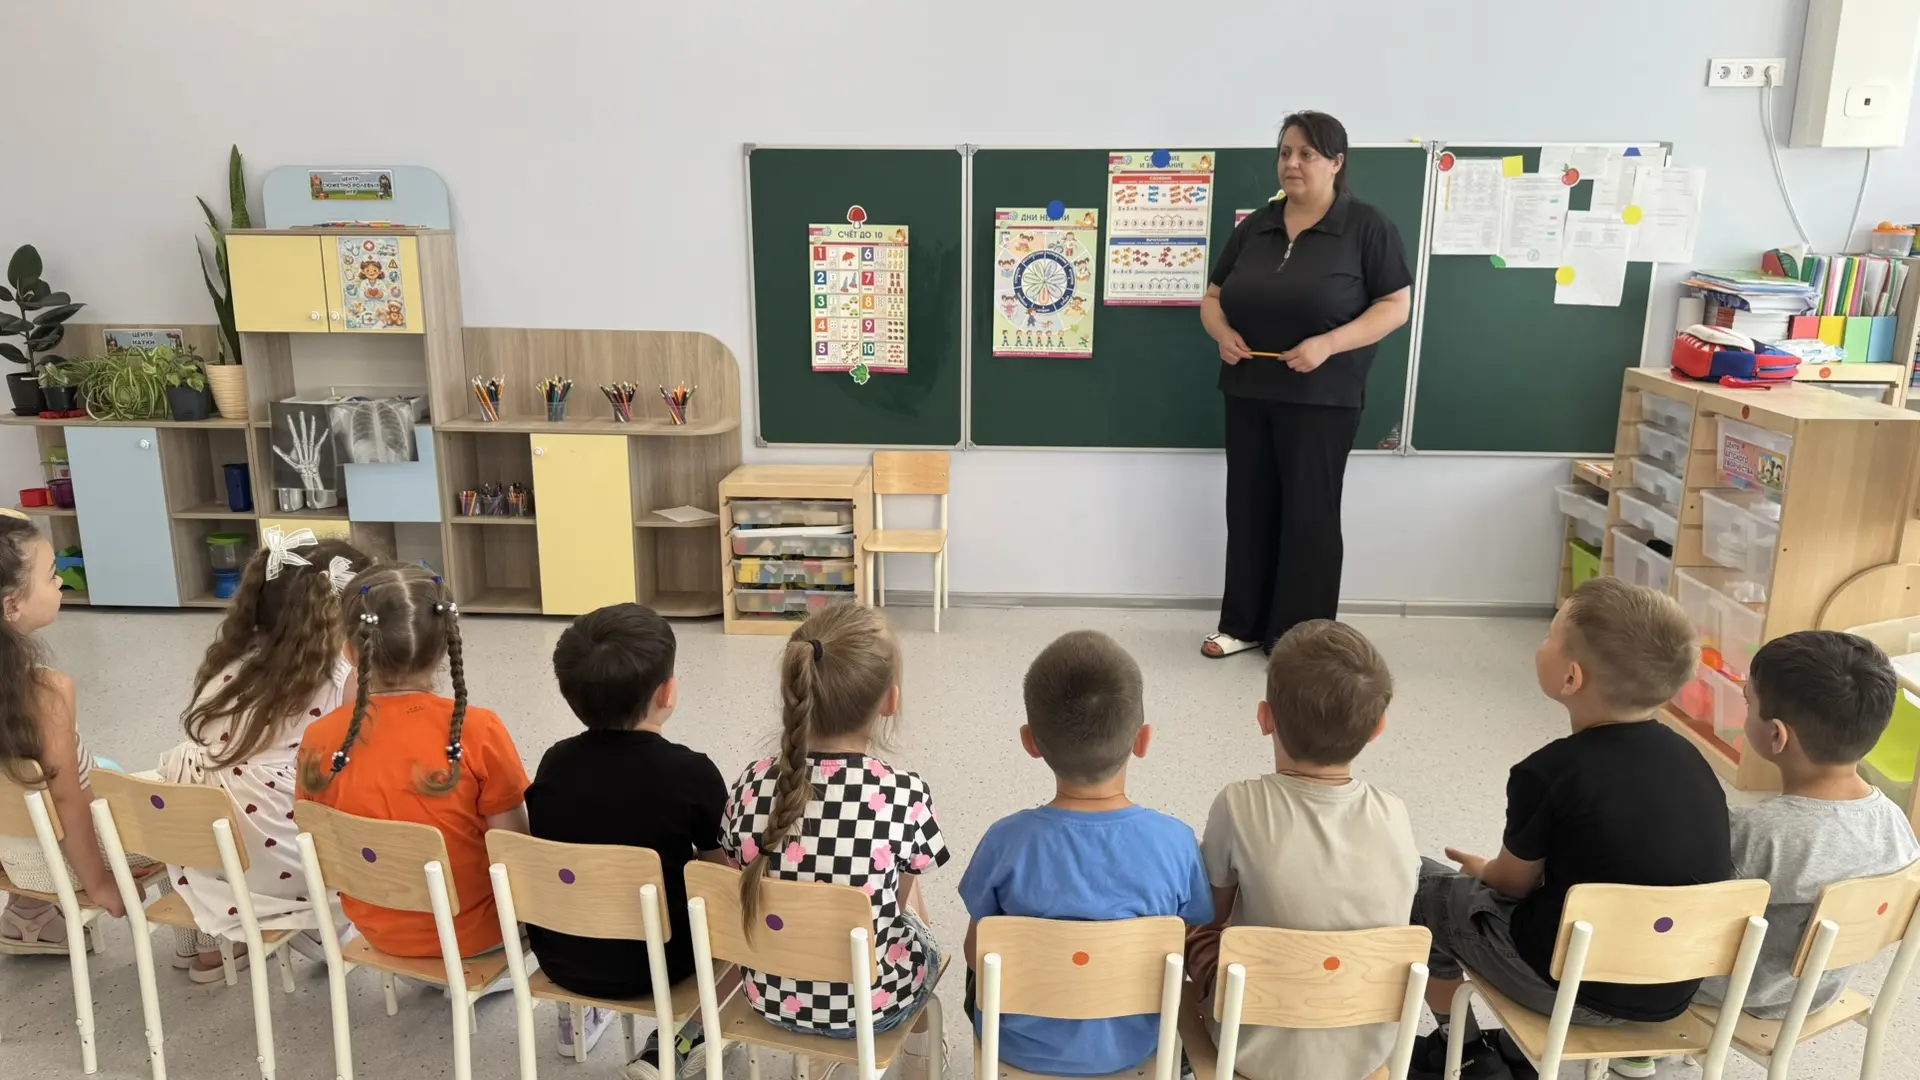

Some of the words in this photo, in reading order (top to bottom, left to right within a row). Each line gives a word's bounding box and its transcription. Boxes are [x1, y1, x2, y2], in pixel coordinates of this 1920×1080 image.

[838, 230, 857, 239] СЧЁТ
[860, 231, 872, 239] ДО
[875, 231, 883, 239] 10
[817, 248, 823, 259] 1
[864, 248, 872, 260] 6
[817, 272, 825, 283] 2
[864, 273, 872, 284] 7
[817, 296, 825, 307] 3
[865, 296, 872, 307] 8
[817, 320, 826, 331] 4
[865, 320, 872, 331] 9
[818, 343, 826, 354] 5
[863, 343, 874, 354] 10
